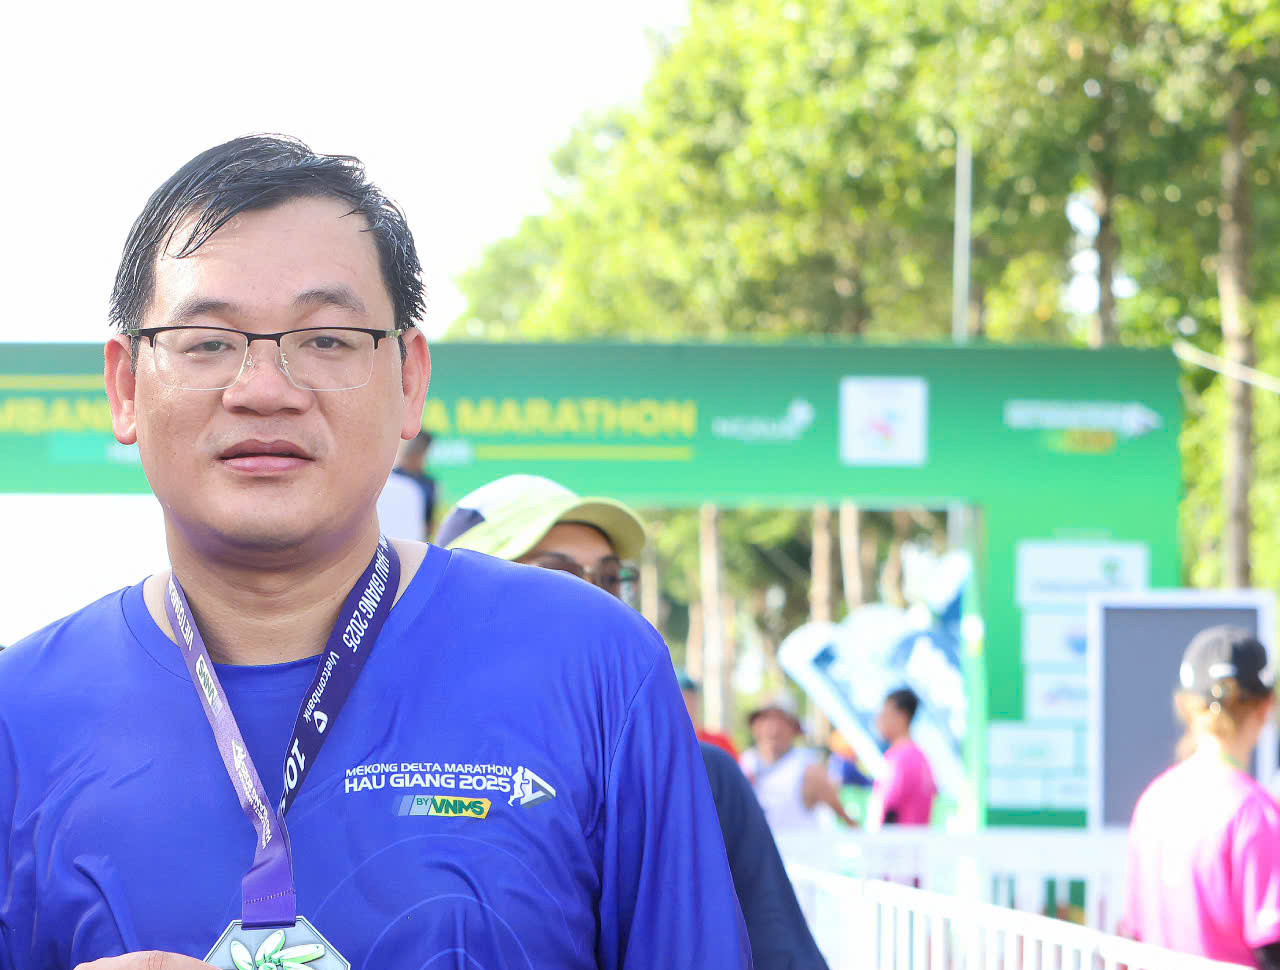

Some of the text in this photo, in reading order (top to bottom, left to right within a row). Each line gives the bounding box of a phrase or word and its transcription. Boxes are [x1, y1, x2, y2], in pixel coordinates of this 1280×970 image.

[456, 397, 698, 437] MARATHON
[342, 547, 390, 653] HAU GIANG 2025
[302, 651, 340, 723] Vietcombank
[344, 774, 511, 794] HAU GIANG 2025
[345, 762, 512, 778] MEKONG DELTA MARATHON
[416, 798, 485, 816] BY VNMS
